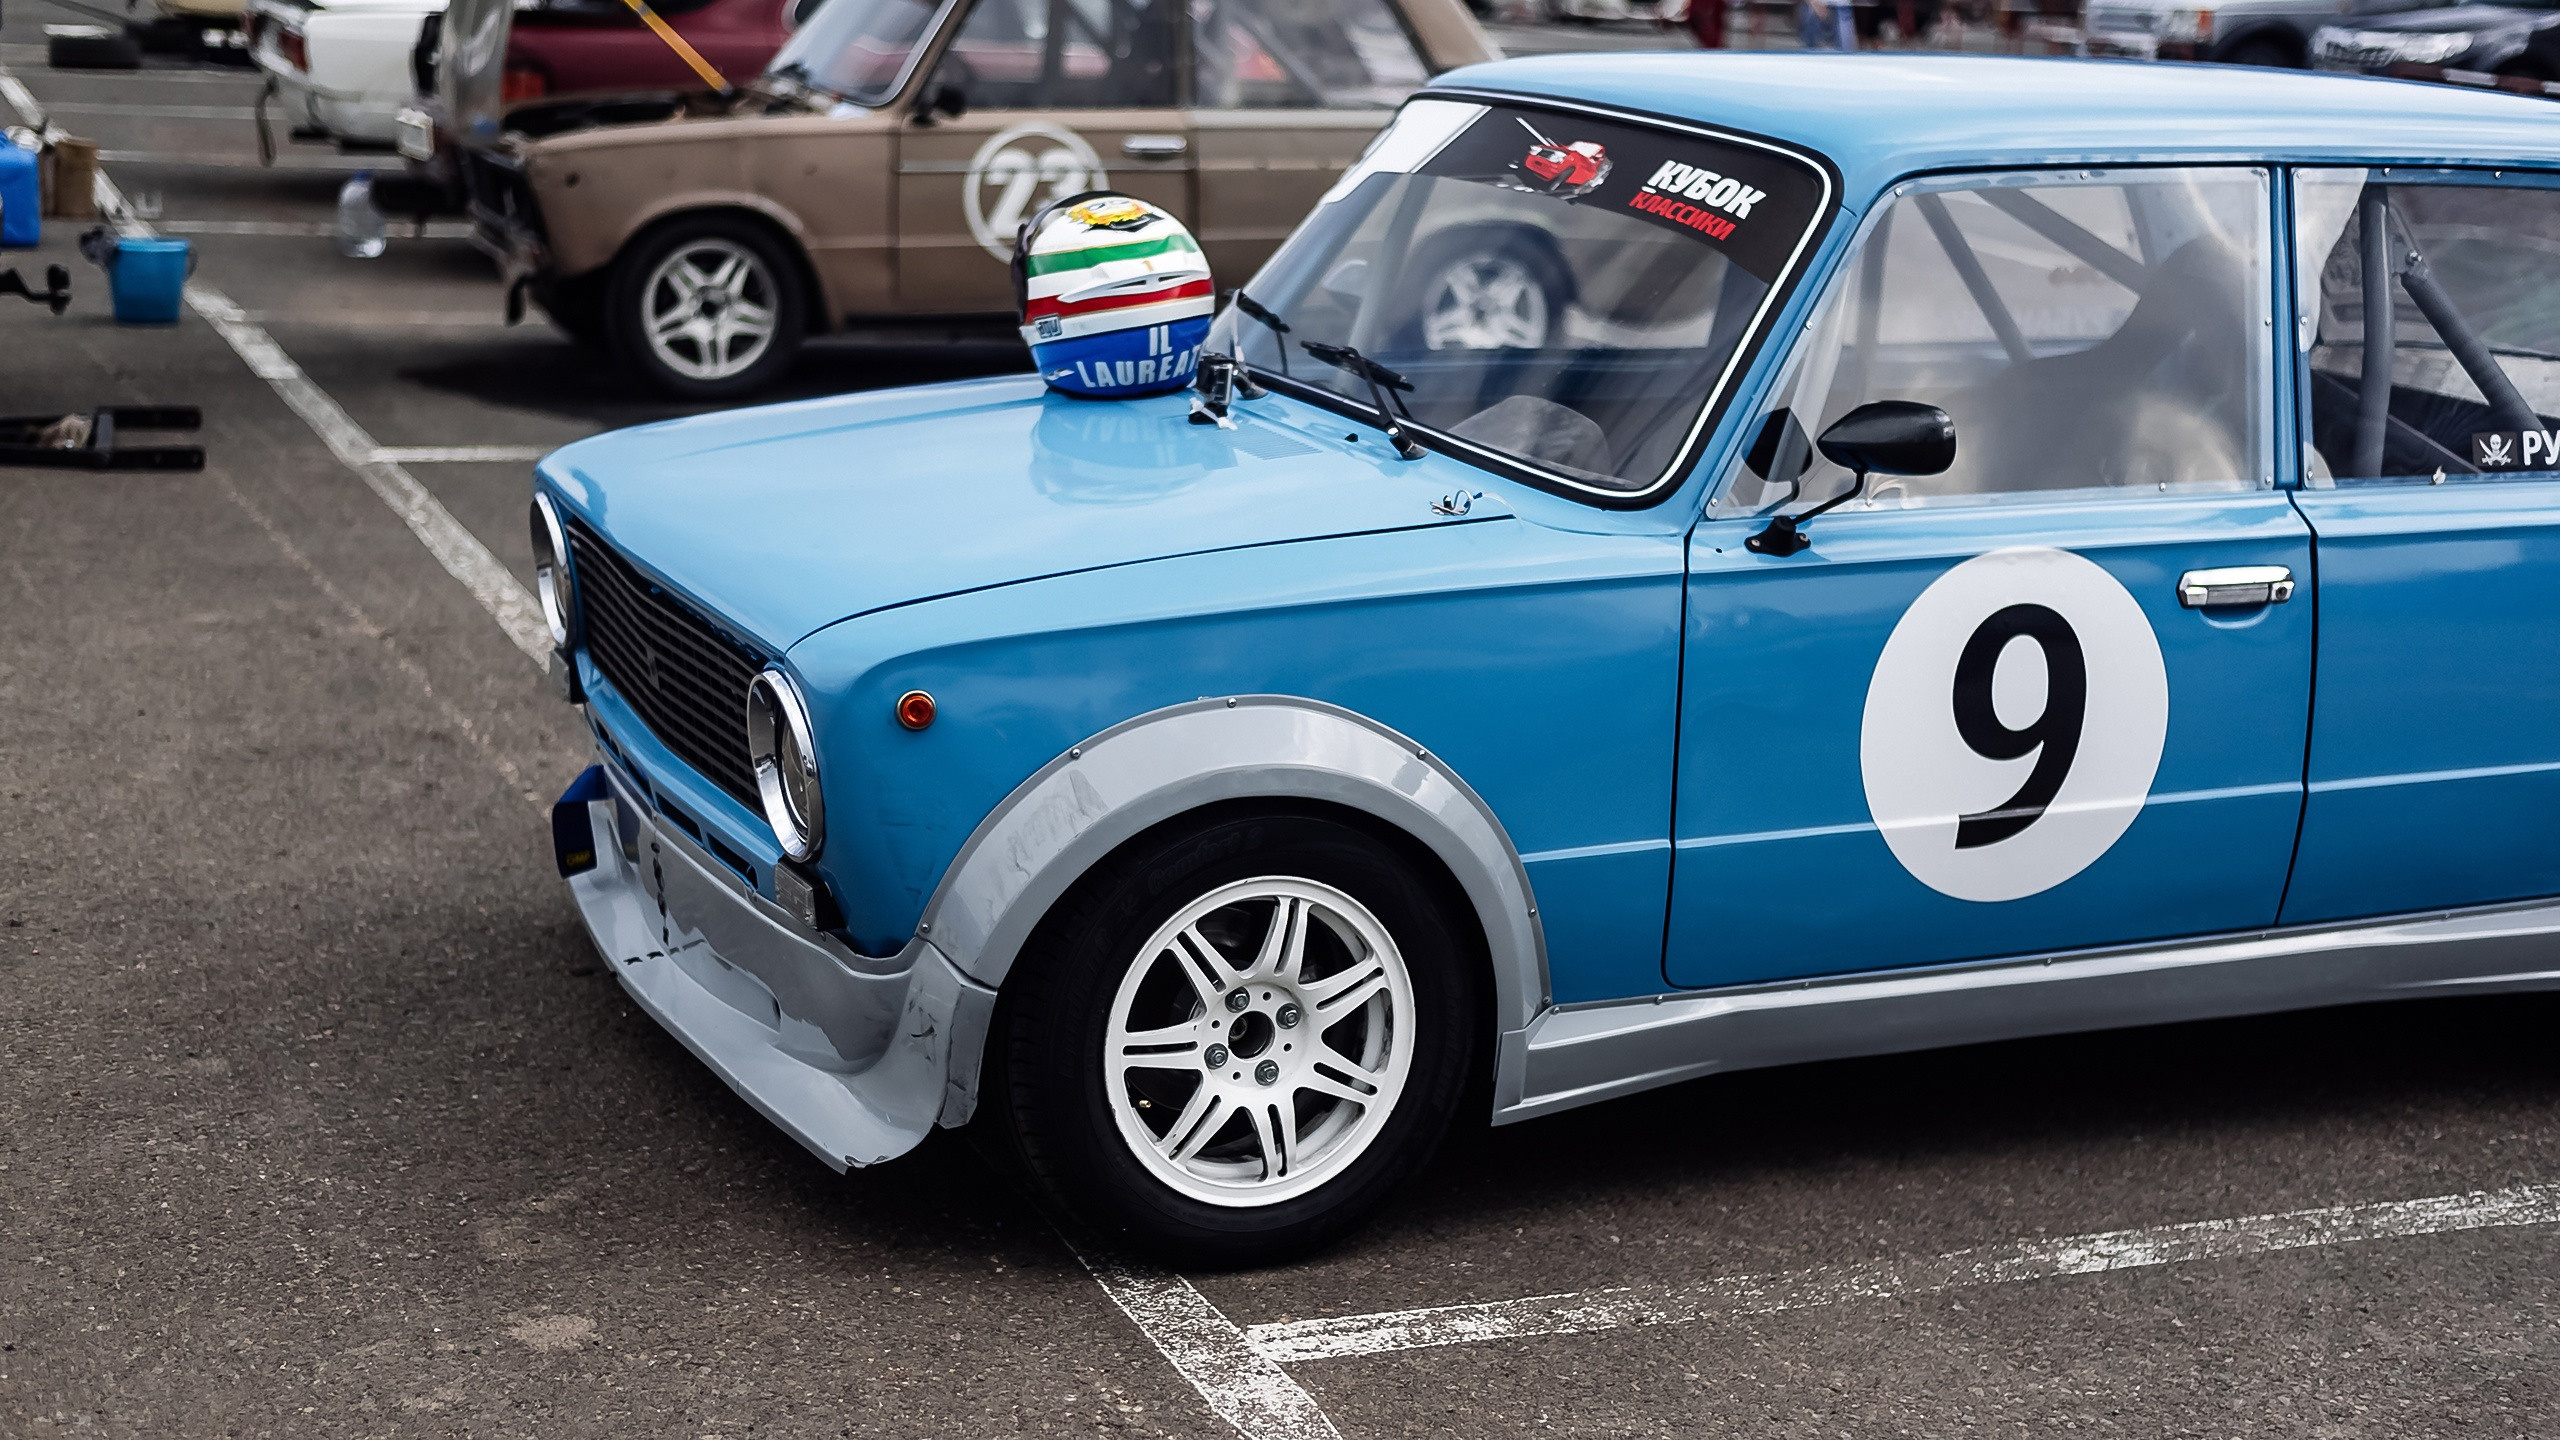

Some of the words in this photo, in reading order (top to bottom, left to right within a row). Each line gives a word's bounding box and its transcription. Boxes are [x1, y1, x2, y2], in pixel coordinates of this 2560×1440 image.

[985, 149, 1089, 239] 23
[1628, 190, 1737, 241] КЛАССИКИ
[1647, 159, 1767, 219] КУБОК
[1149, 324, 1173, 356] IL
[1952, 603, 2088, 850] 9
